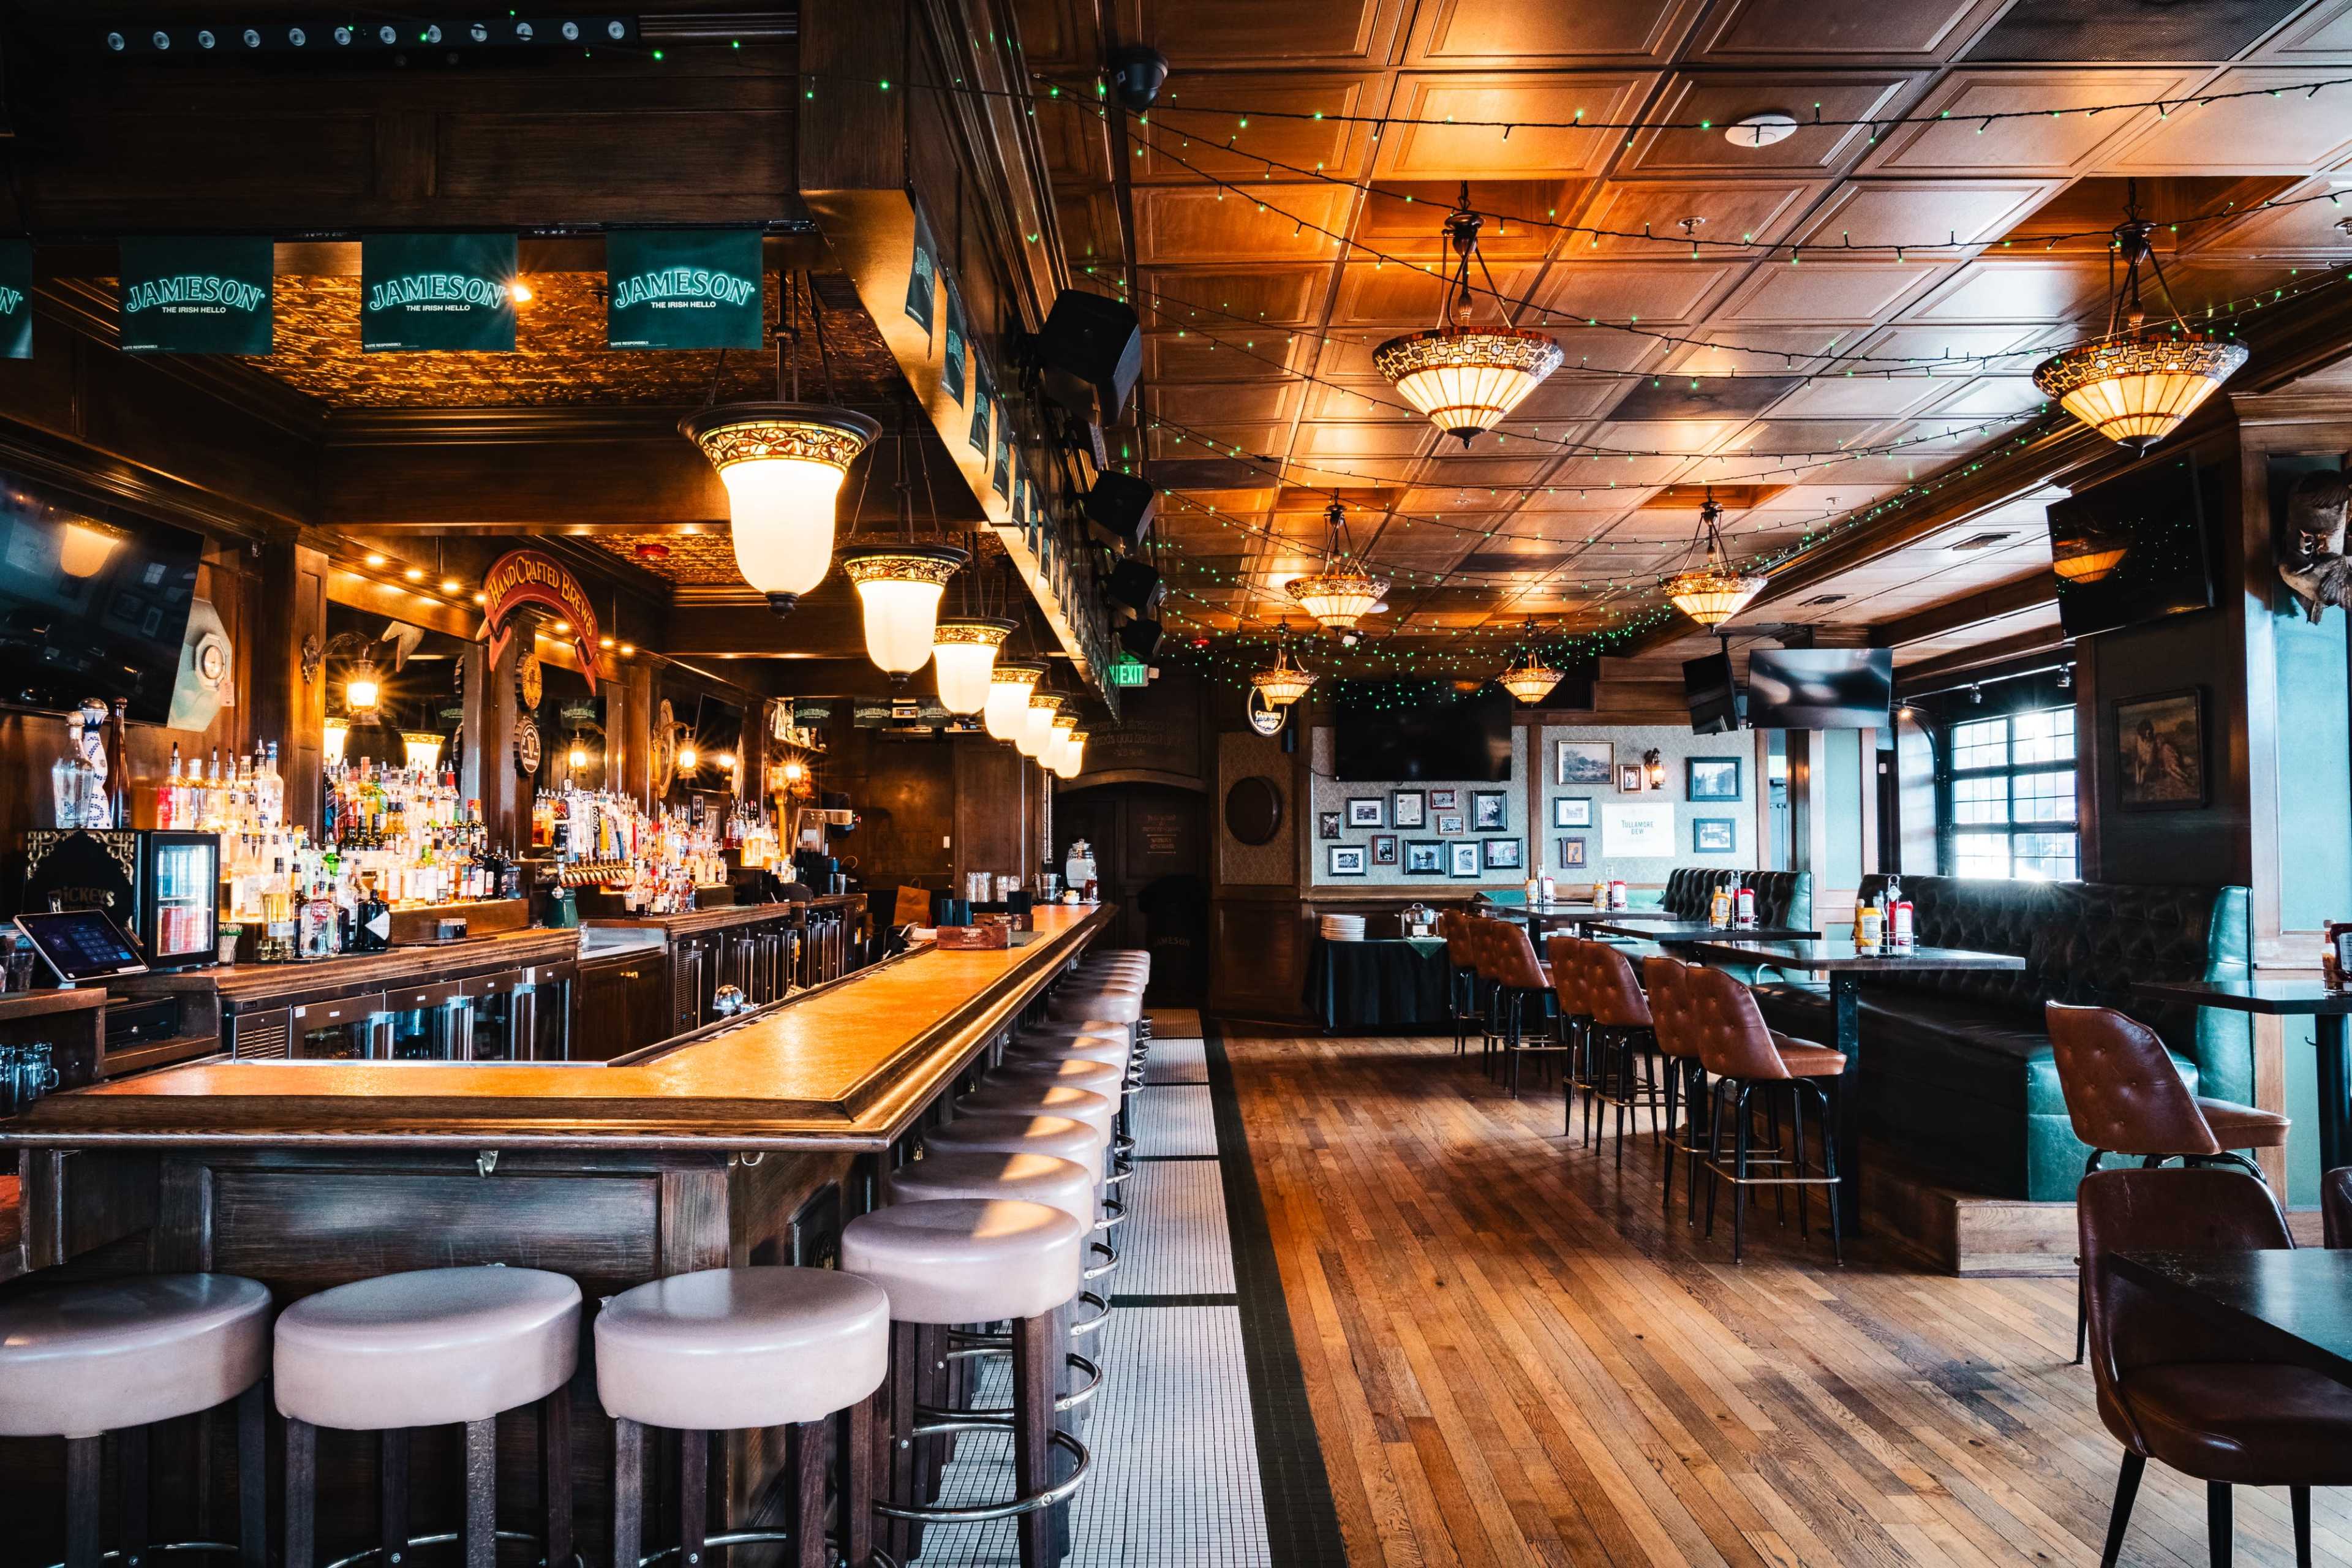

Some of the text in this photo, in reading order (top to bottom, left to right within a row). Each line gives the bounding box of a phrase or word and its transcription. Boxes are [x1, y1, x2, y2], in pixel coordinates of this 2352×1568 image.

[126, 276, 262, 313] JAMESON
[369, 274, 507, 311] JAMESON
[615, 271, 751, 308] JAMESON
[1120, 665, 1144, 684] EXIT
[1622, 820, 1654, 829] TULLAMORE
